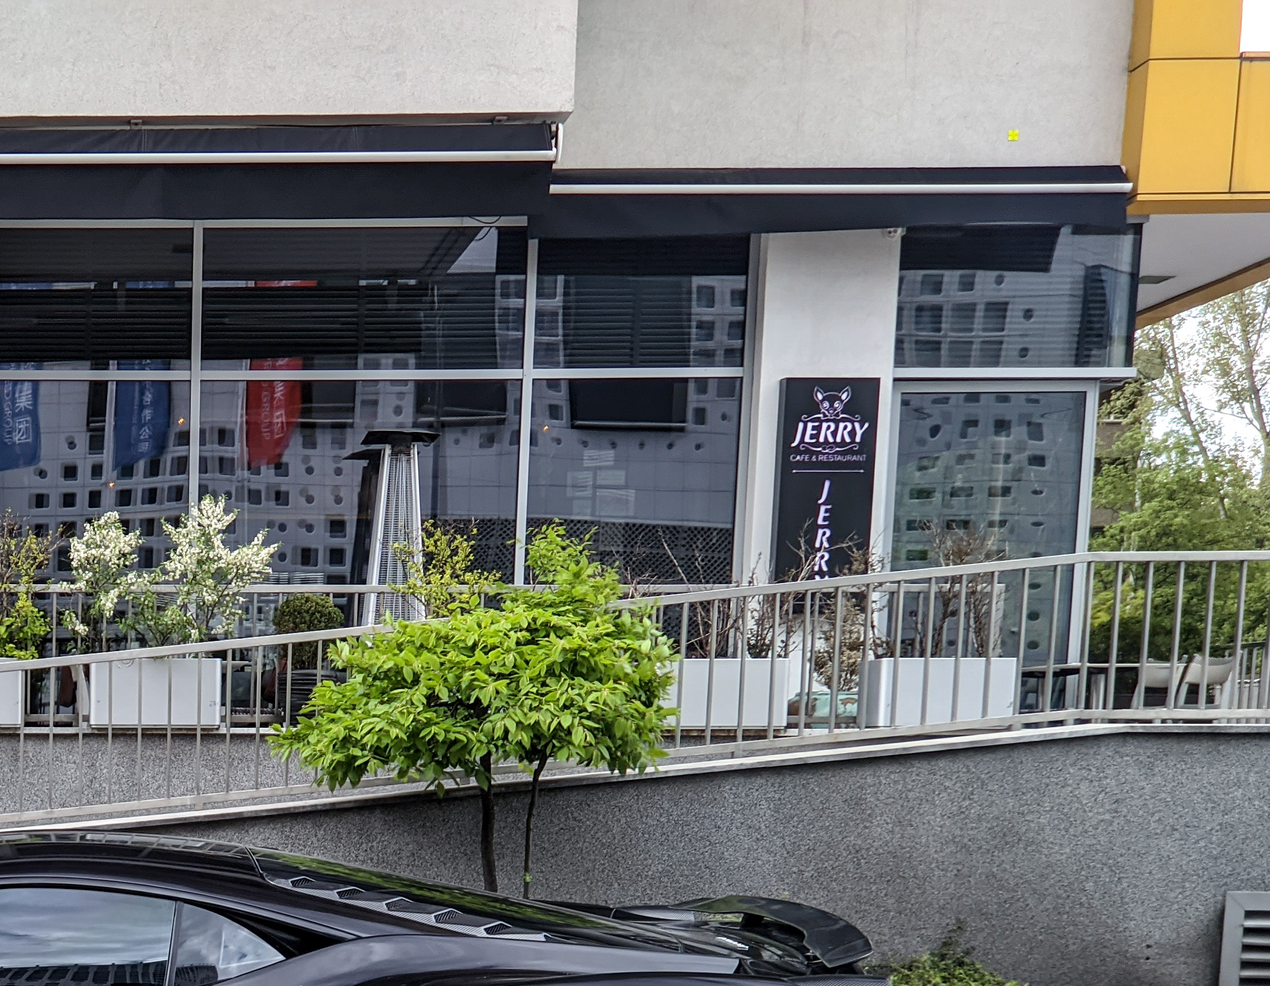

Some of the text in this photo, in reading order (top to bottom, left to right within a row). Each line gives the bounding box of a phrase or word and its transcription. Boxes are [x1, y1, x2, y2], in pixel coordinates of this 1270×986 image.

[790, 422, 869, 447] JERRY
[790, 453, 867, 462] CAFE & RESTAURANT
[812, 479, 833, 579] JERR
